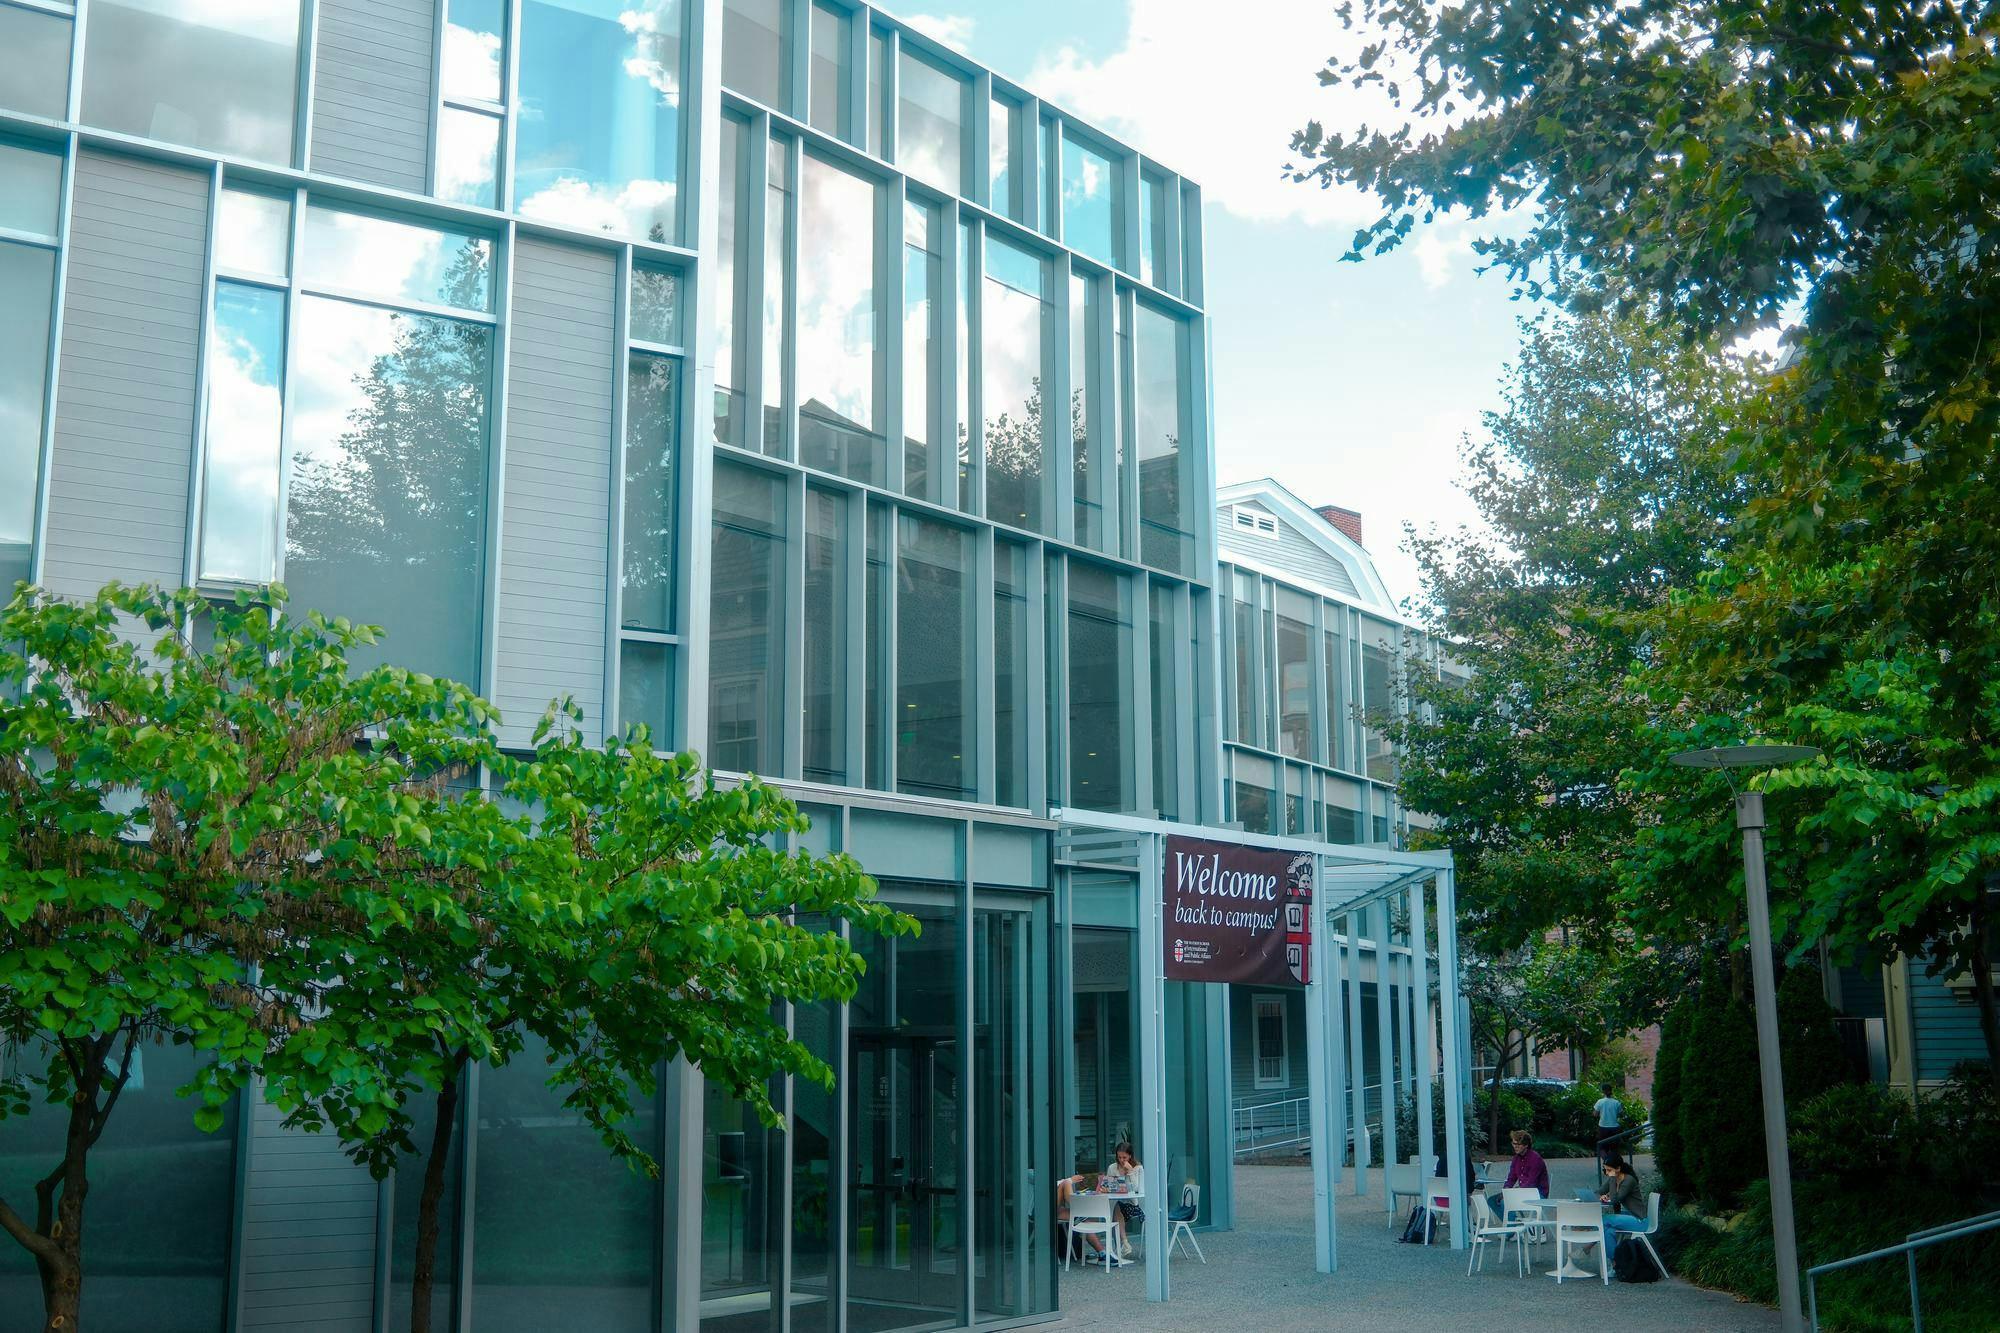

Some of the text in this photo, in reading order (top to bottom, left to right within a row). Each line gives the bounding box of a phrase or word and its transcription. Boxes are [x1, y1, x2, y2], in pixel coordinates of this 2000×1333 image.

[1175, 852, 1277, 901] Welcome
[1175, 898, 1278, 937] back to campus!
